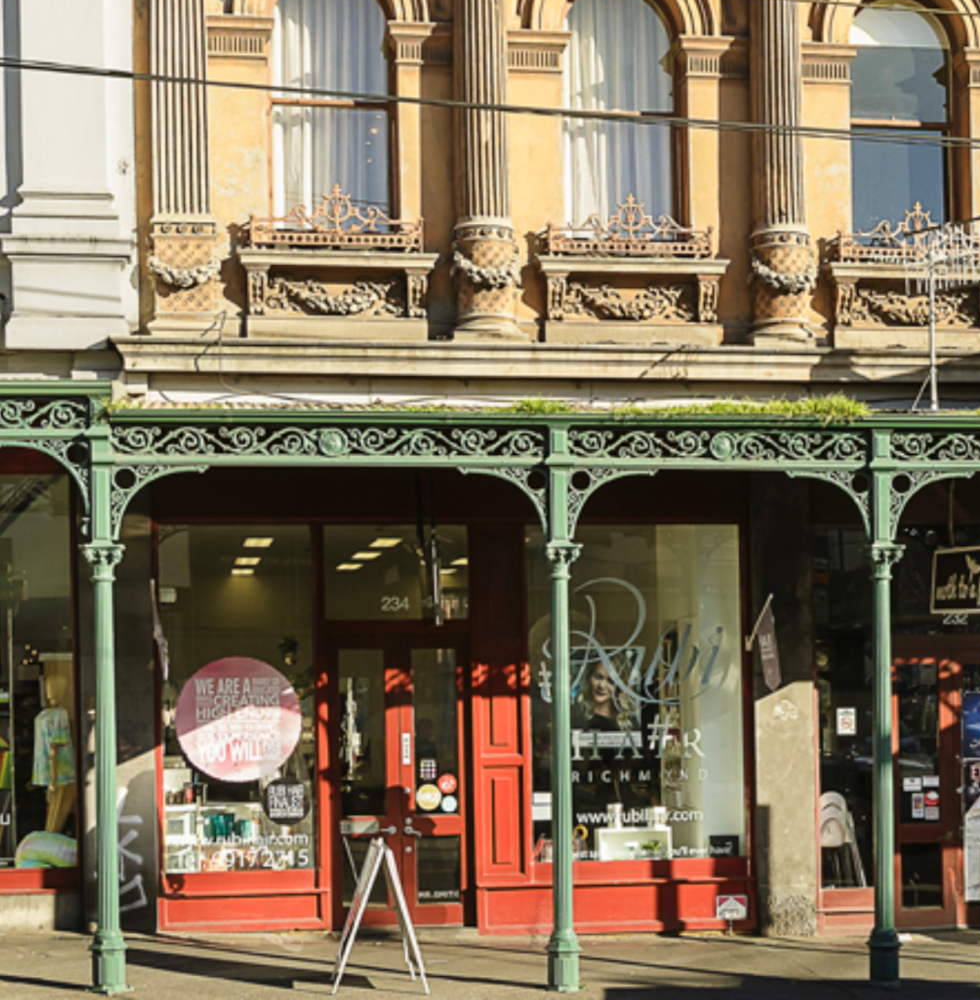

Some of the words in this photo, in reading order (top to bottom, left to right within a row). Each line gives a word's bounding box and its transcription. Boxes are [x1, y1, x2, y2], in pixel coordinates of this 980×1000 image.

[381, 595, 409, 612] 234
[194, 677, 215, 696] WE
[216, 677, 241, 695] ARE
[213, 694, 279, 707] CREATING
